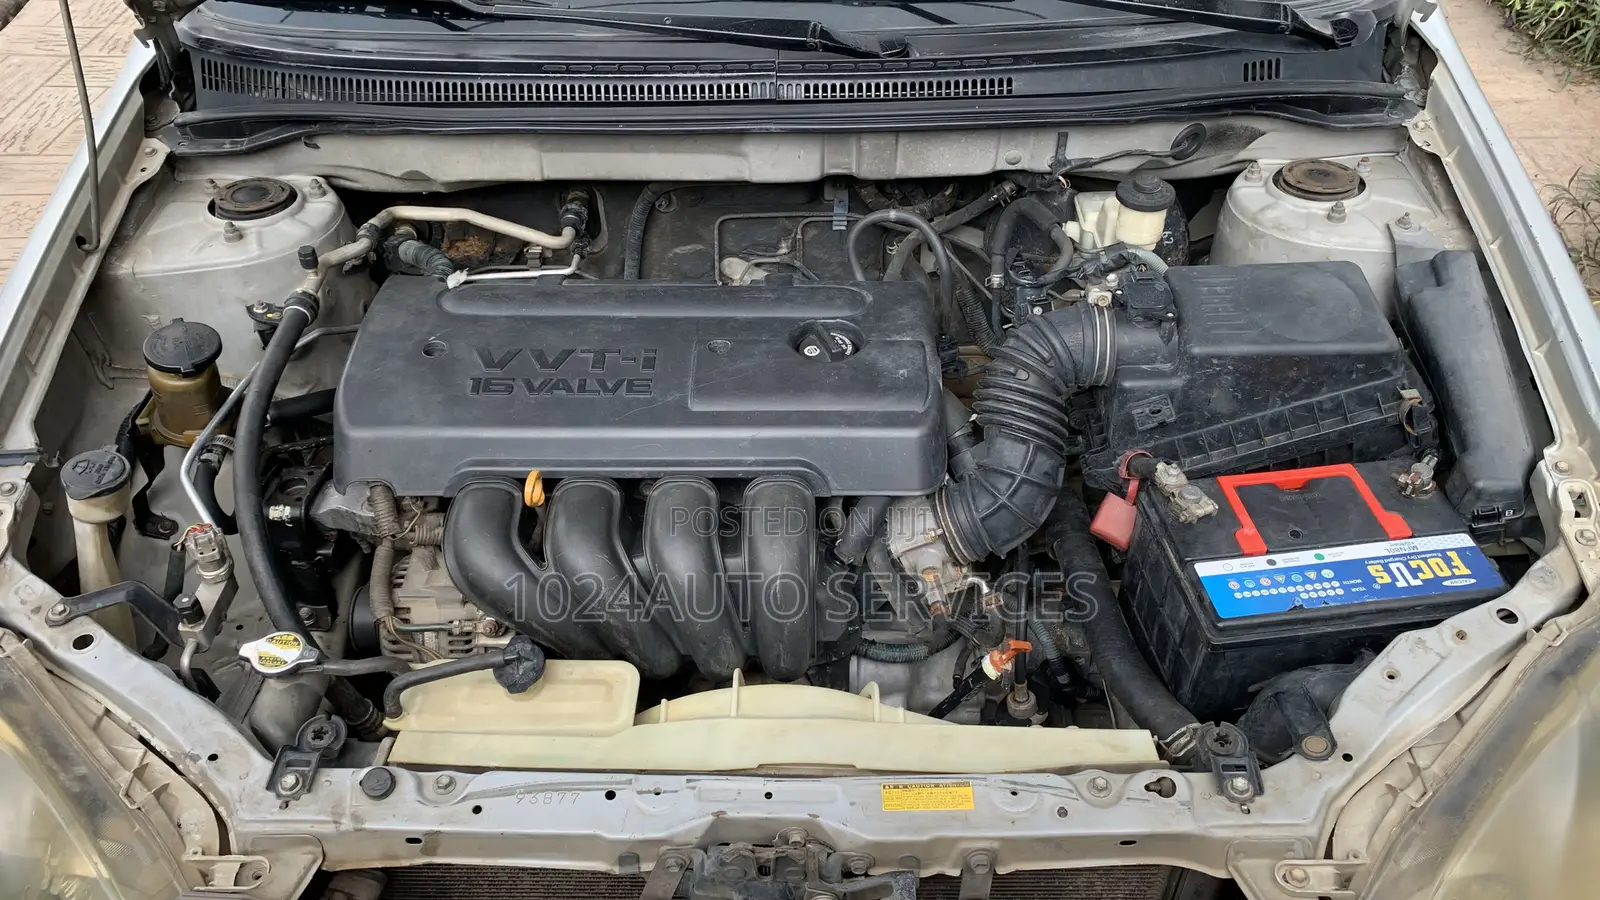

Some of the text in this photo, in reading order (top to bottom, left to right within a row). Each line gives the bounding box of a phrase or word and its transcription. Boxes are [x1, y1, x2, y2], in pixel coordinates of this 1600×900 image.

[474, 348, 657, 372] VVT-i
[469, 377, 654, 397] 16 VALVE
[1364, 558, 1385, 566] Battery
[1367, 550, 1472, 588] FOCUS
